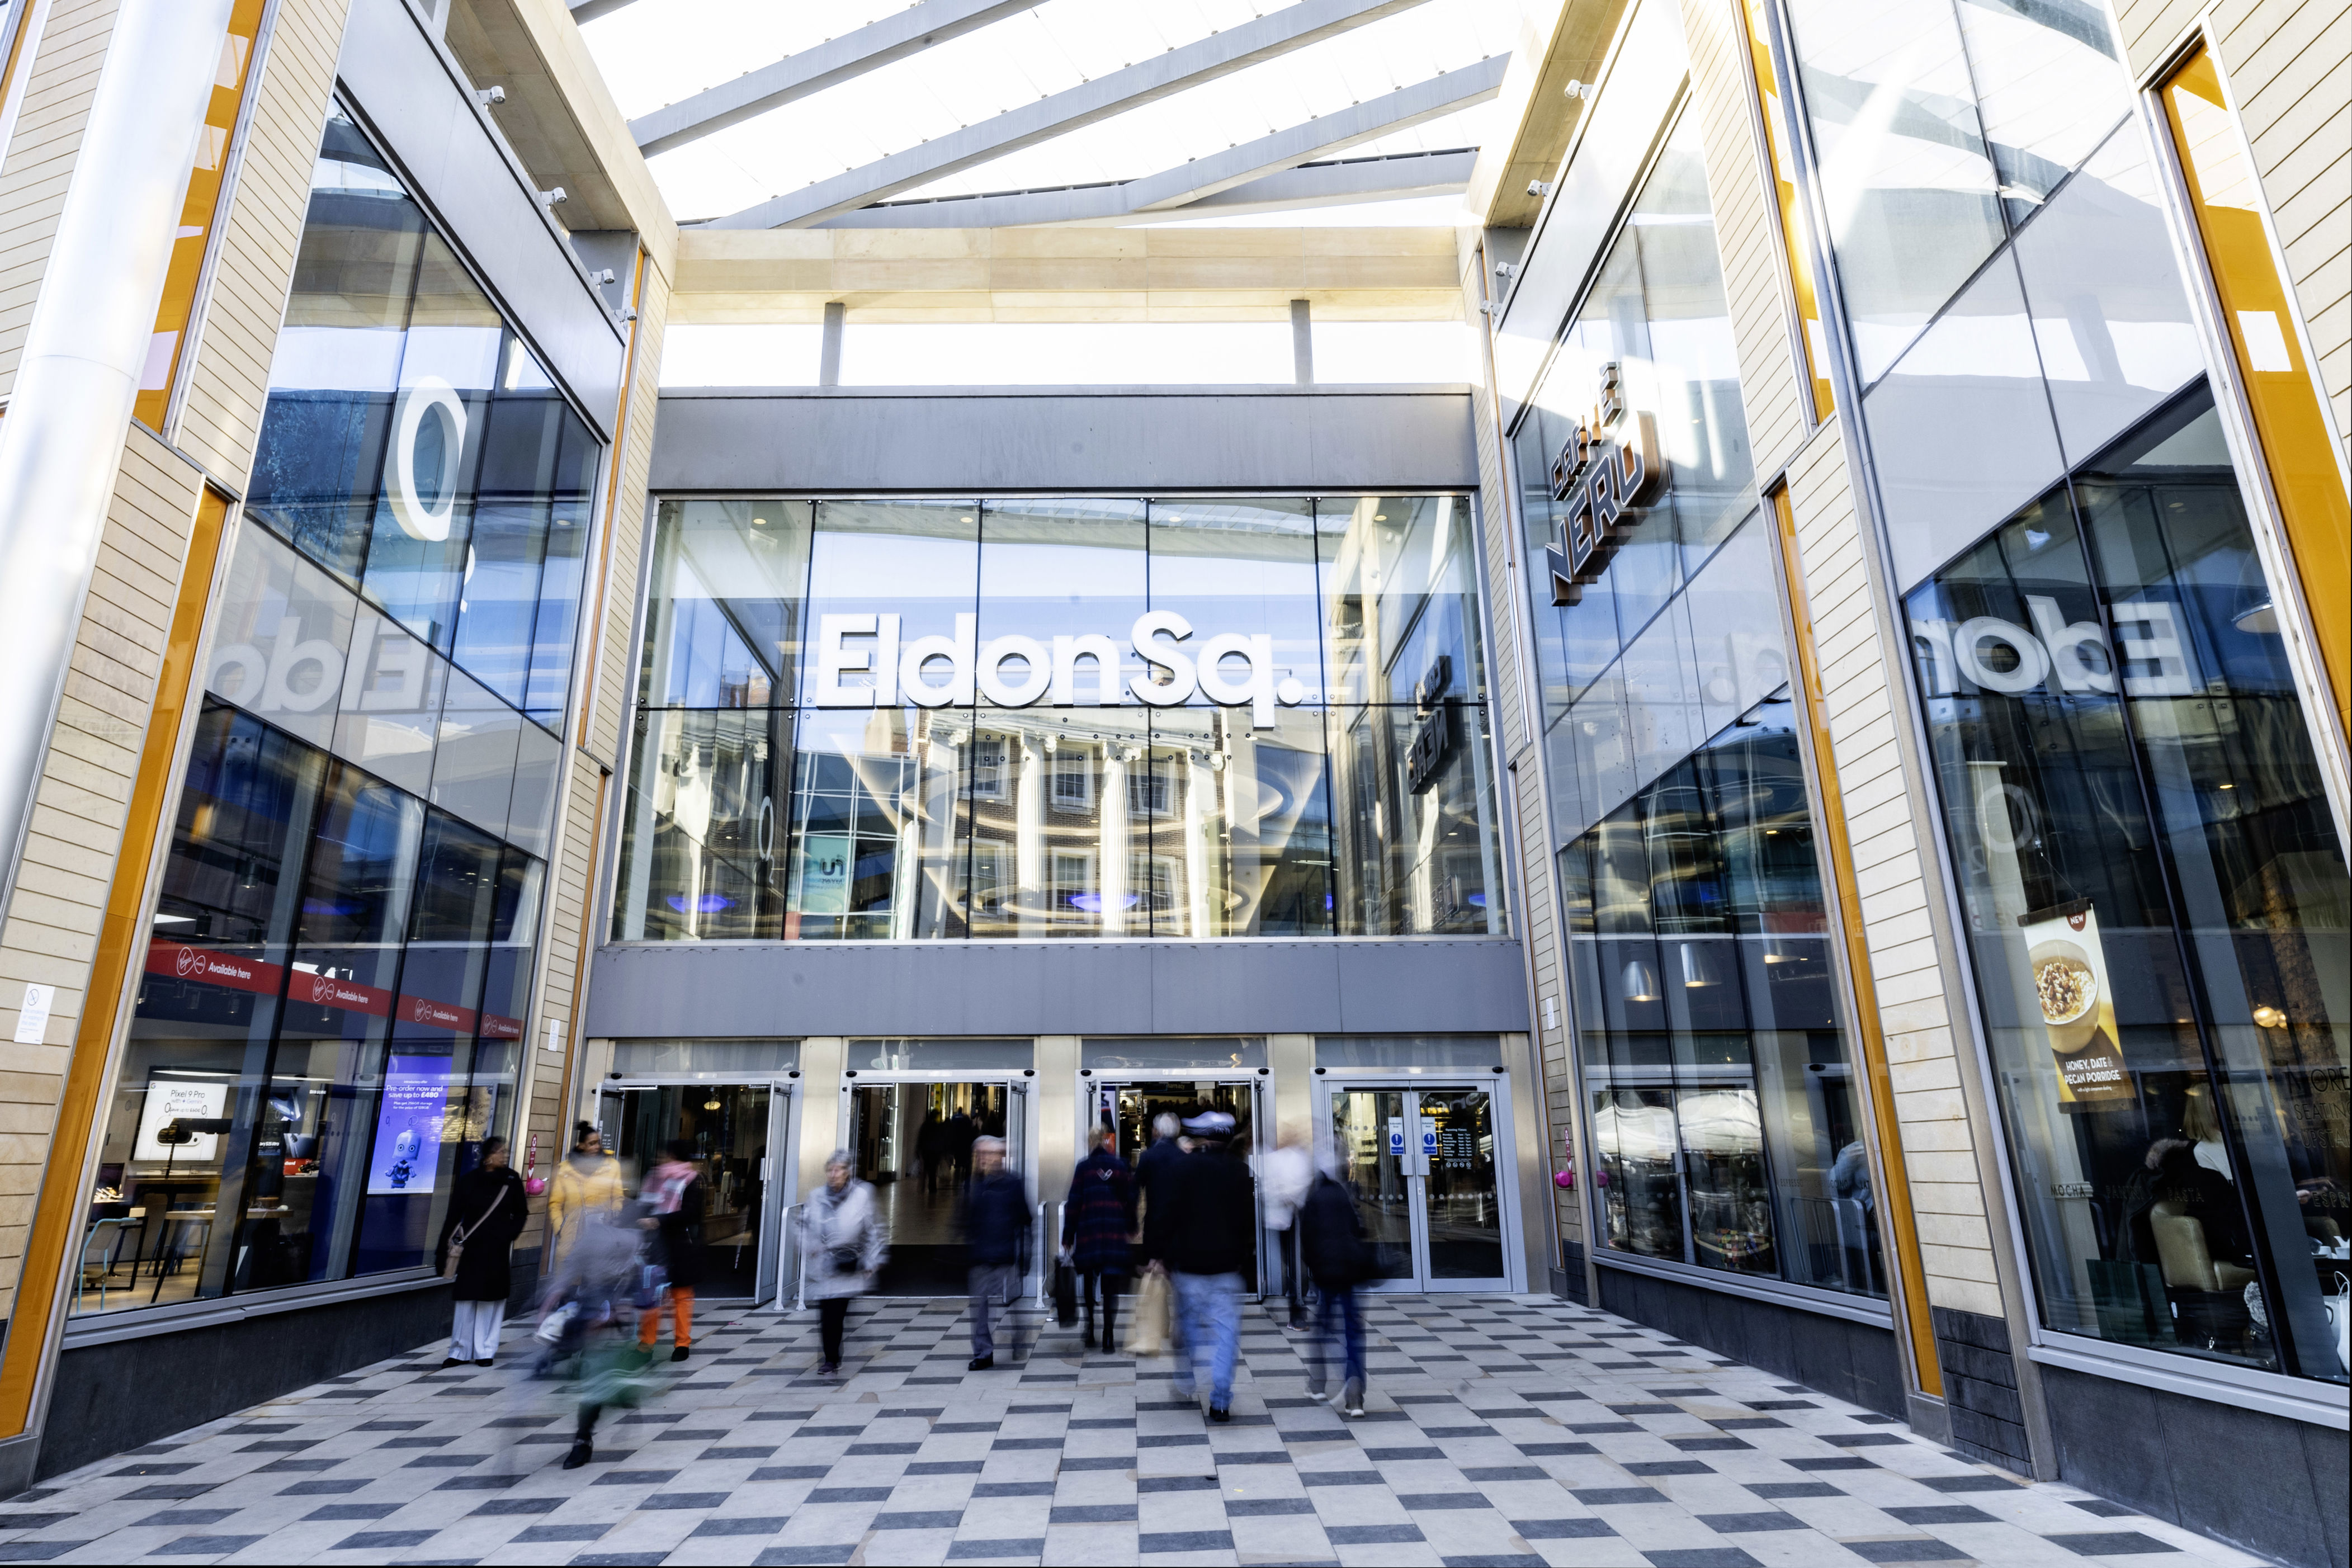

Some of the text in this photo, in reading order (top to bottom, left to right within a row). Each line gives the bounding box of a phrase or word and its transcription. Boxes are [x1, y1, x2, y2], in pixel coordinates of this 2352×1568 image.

[1545, 410, 1660, 606] NERO
[2070, 914, 2084, 925] NEW
[208, 962, 237, 977] Available
[237, 967, 251, 979] here
[336, 989, 358, 1002] Available
[358, 993, 368, 1004] here
[2066, 1059, 2090, 1071] HONEY,
[2090, 1057, 2107, 1069] DATE
[2064, 1070, 2121, 1084] PECAN PORRIDGE
[2051, 1184, 2087, 1198] MOCHA
[2167, 1186, 2205, 1202] PASTA
[2312, 1191, 2351, 1208] ESPR
